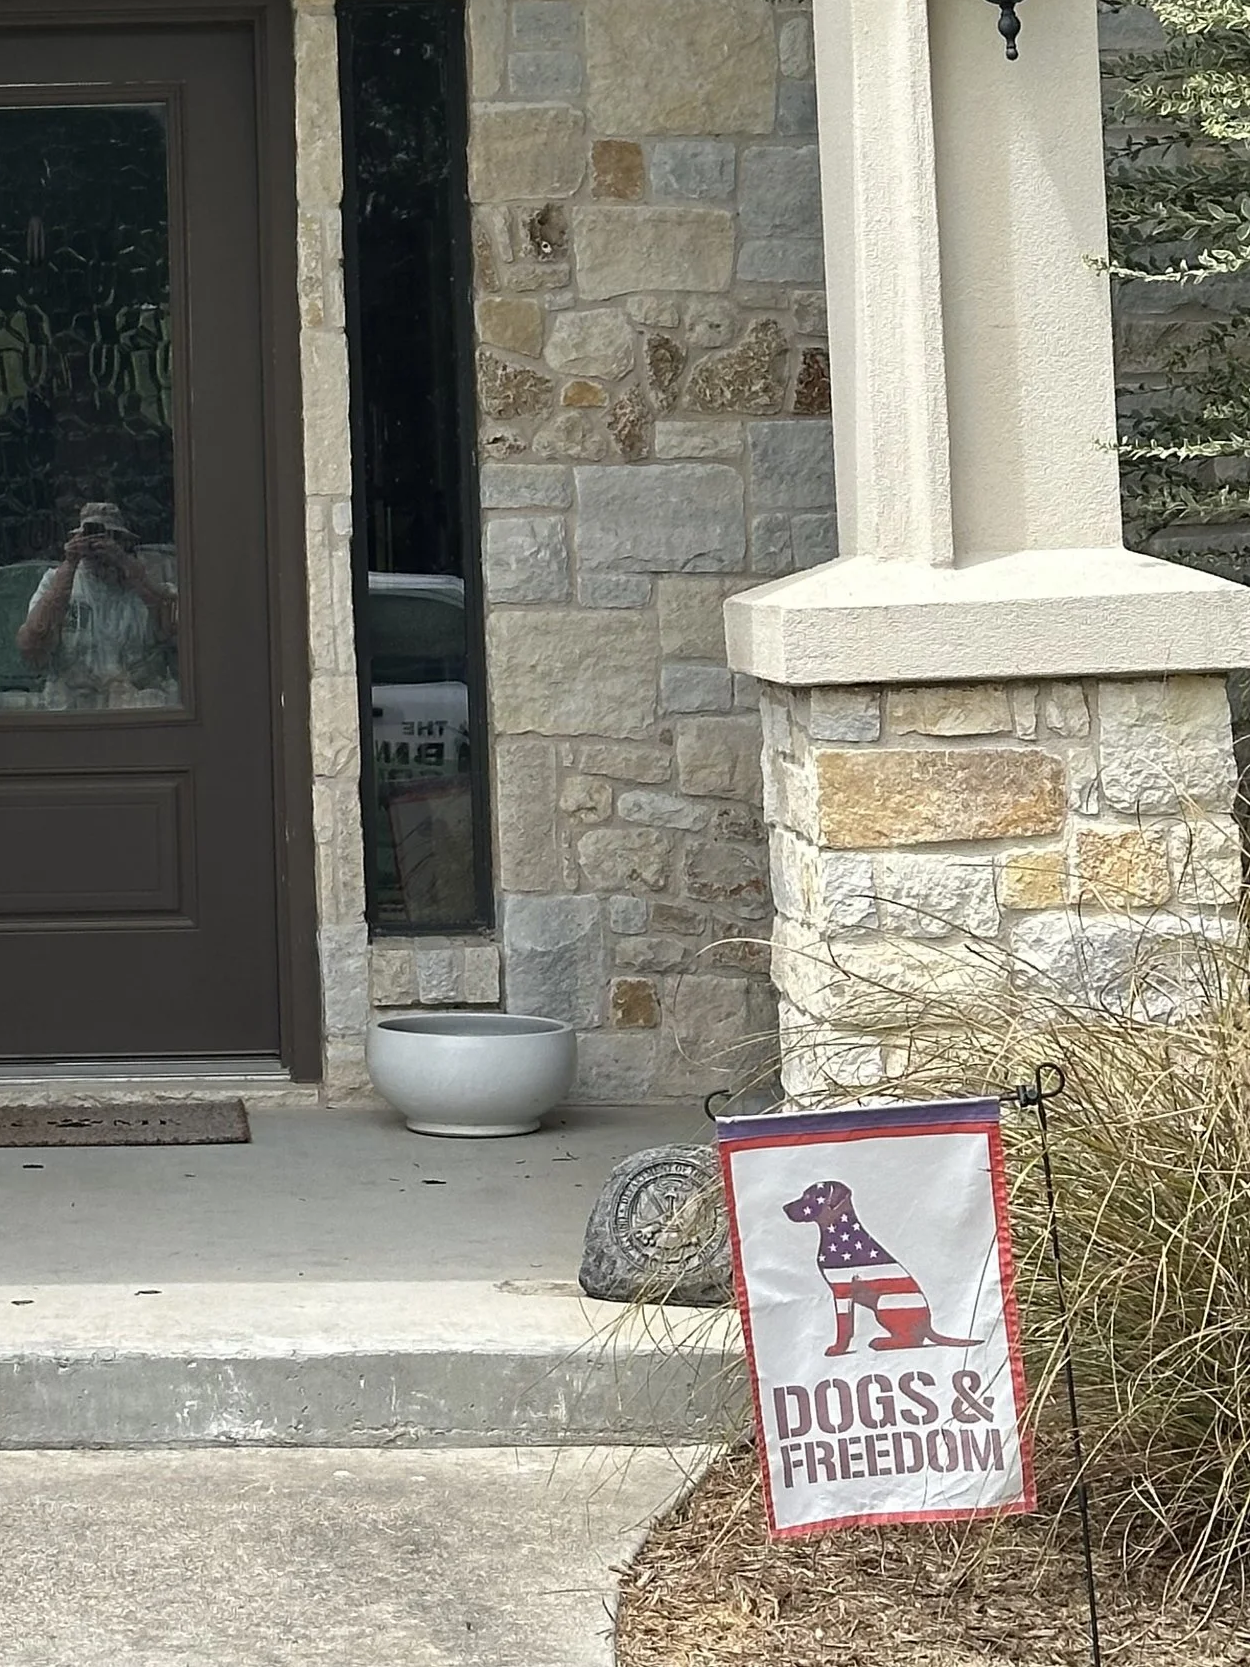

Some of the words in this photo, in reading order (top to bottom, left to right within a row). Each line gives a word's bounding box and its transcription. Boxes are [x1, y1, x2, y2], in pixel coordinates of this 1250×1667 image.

[773, 1370, 937, 1440] DOGS
[950, 1369, 995, 1424] &
[779, 1427, 1005, 1489] FREEDOM
